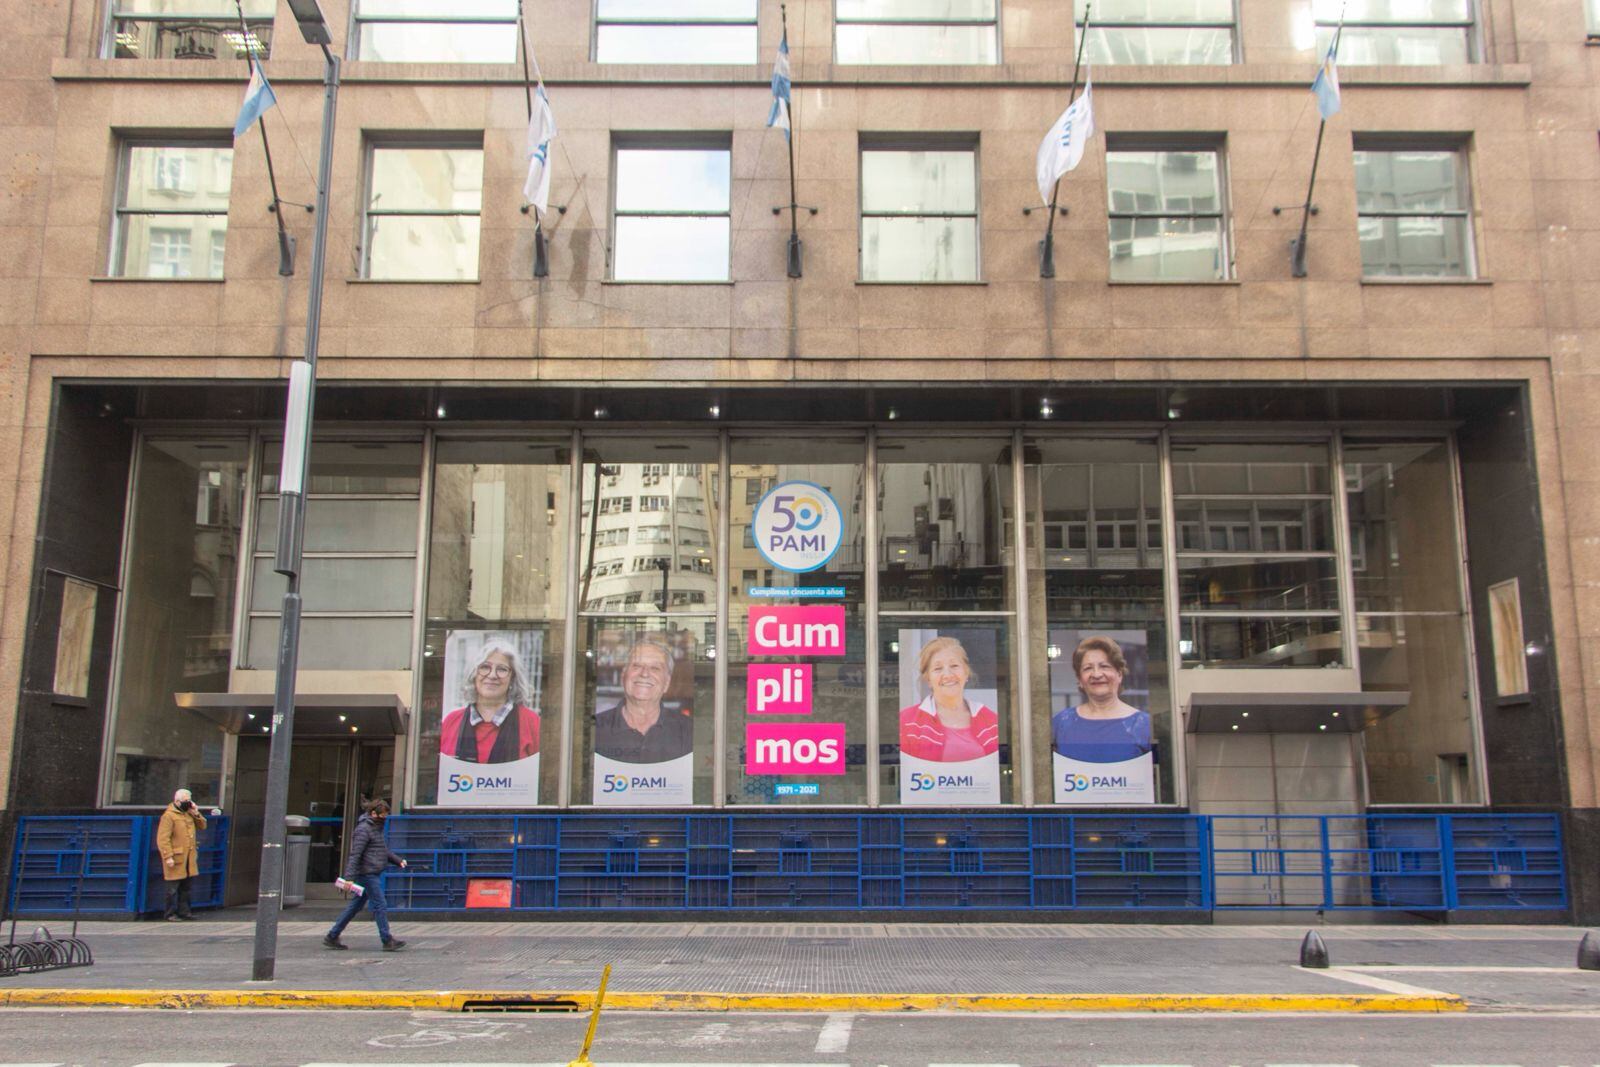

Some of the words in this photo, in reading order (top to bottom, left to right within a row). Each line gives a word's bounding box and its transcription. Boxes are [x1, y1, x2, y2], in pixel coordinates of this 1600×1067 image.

[771, 495, 823, 533] 50
[770, 535, 825, 551] PAMI
[750, 587, 789, 597] Cumplimos
[791, 587, 825, 596] cincuenta
[826, 587, 843, 596] años
[755, 615, 840, 648] Cum
[756, 668, 804, 711] pli
[756, 739, 839, 764] mos
[448, 774, 473, 792] 50
[476, 777, 512, 788] PAMI
[603, 774, 628, 793] 50
[631, 777, 667, 788] PAMI
[777, 785, 794, 793] 1971
[800, 785, 817, 793] 2021
[910, 773, 935, 791] 50
[938, 775, 973, 787] PAMI
[1064, 774, 1089, 792] 50
[1092, 776, 1127, 788] PAMI
